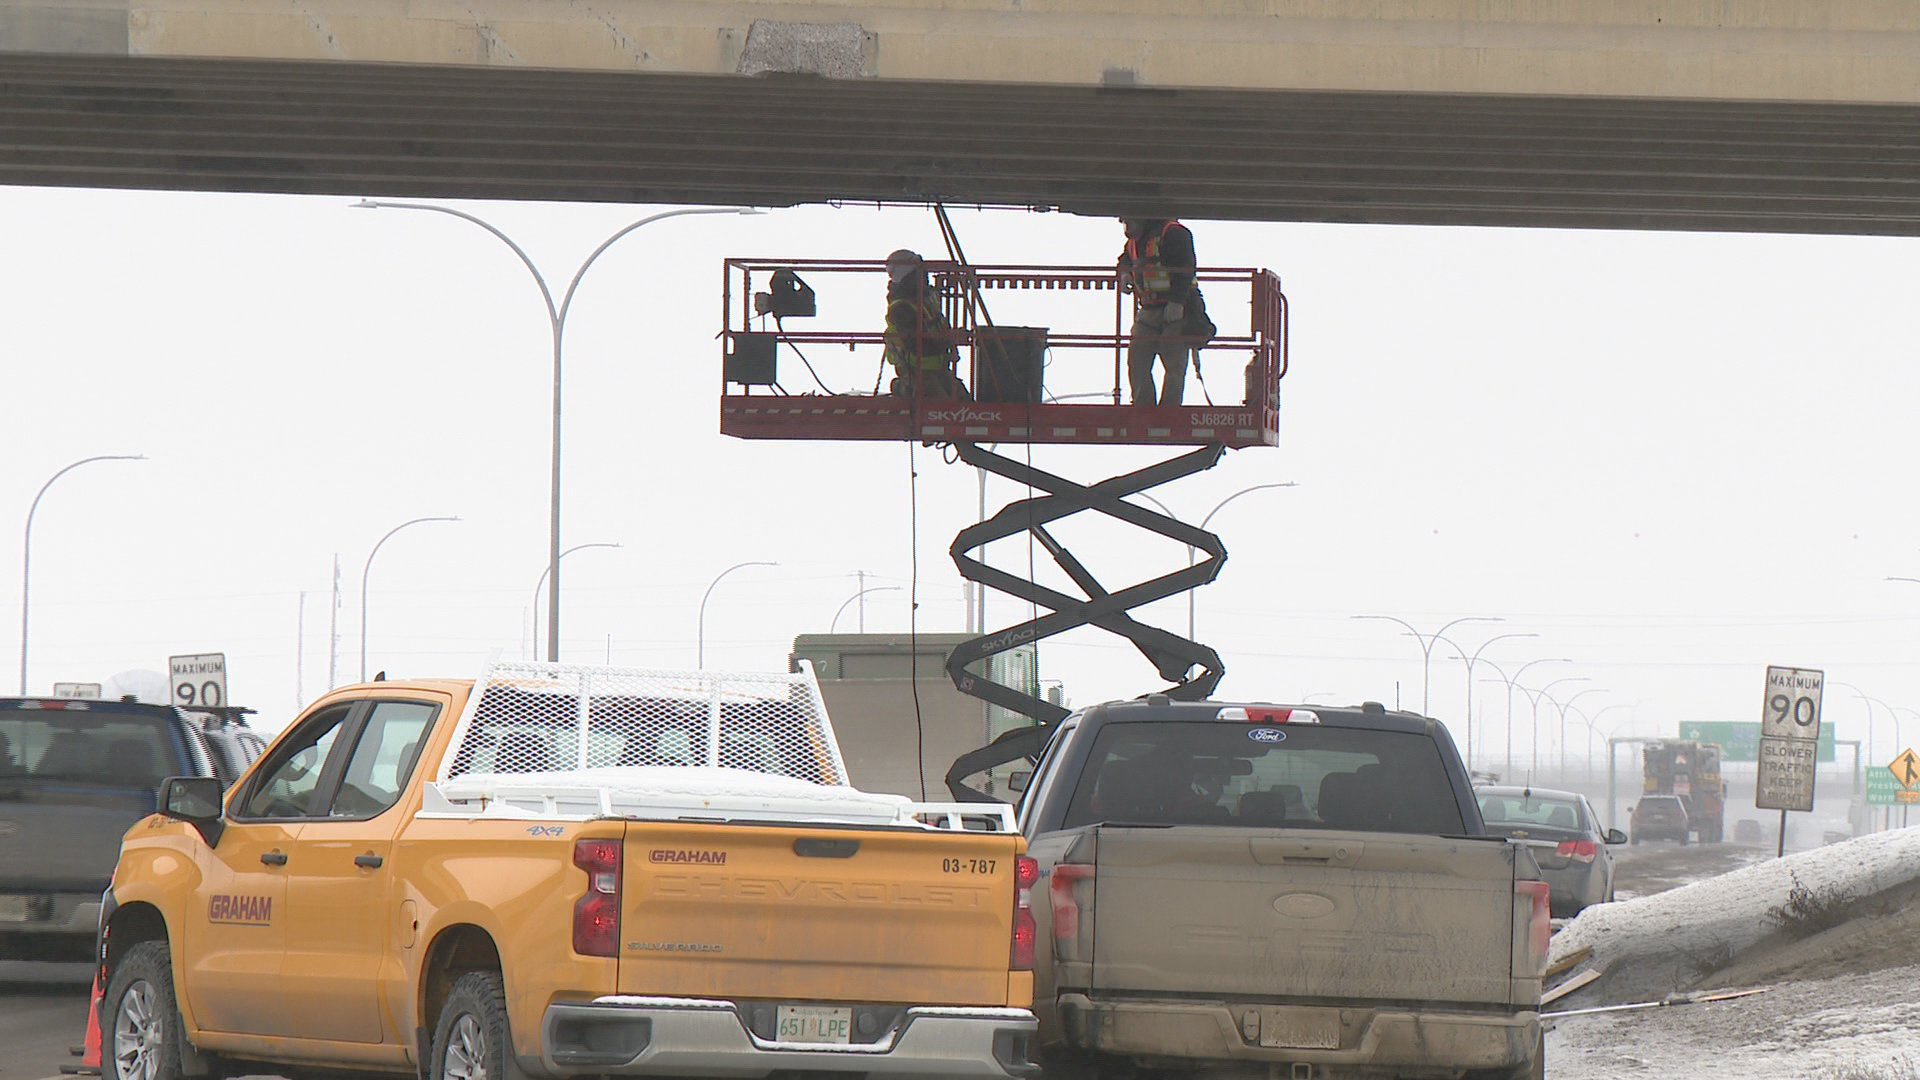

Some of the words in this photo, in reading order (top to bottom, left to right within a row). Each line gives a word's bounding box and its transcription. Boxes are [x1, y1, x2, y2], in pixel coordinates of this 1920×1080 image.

[928, 407, 1002, 422] SKYJACK
[1191, 413, 1234, 426] SJ6826
[1238, 413, 1254, 426] RT
[173, 662, 222, 674] MAXIMUM
[1769, 675, 1820, 689] MAXIMUM
[176, 681, 221, 706] 90
[1770, 694, 1815, 726] 90
[1764, 746, 1812, 758] SLOWER
[1763, 761, 1812, 774] TRAFFIC
[1769, 777, 1802, 788] KEEP
[1768, 791, 1803, 803] RIGHT
[652, 849, 727, 864] GRAHAM
[942, 858, 997, 875] 03-787
[652, 874, 991, 907] CHEVROLET
[210, 895, 272, 921] GRAHAM
[627, 940, 723, 953] SILVERADO
[780, 1018, 805, 1037] 651
[818, 1018, 848, 1037] LPE
